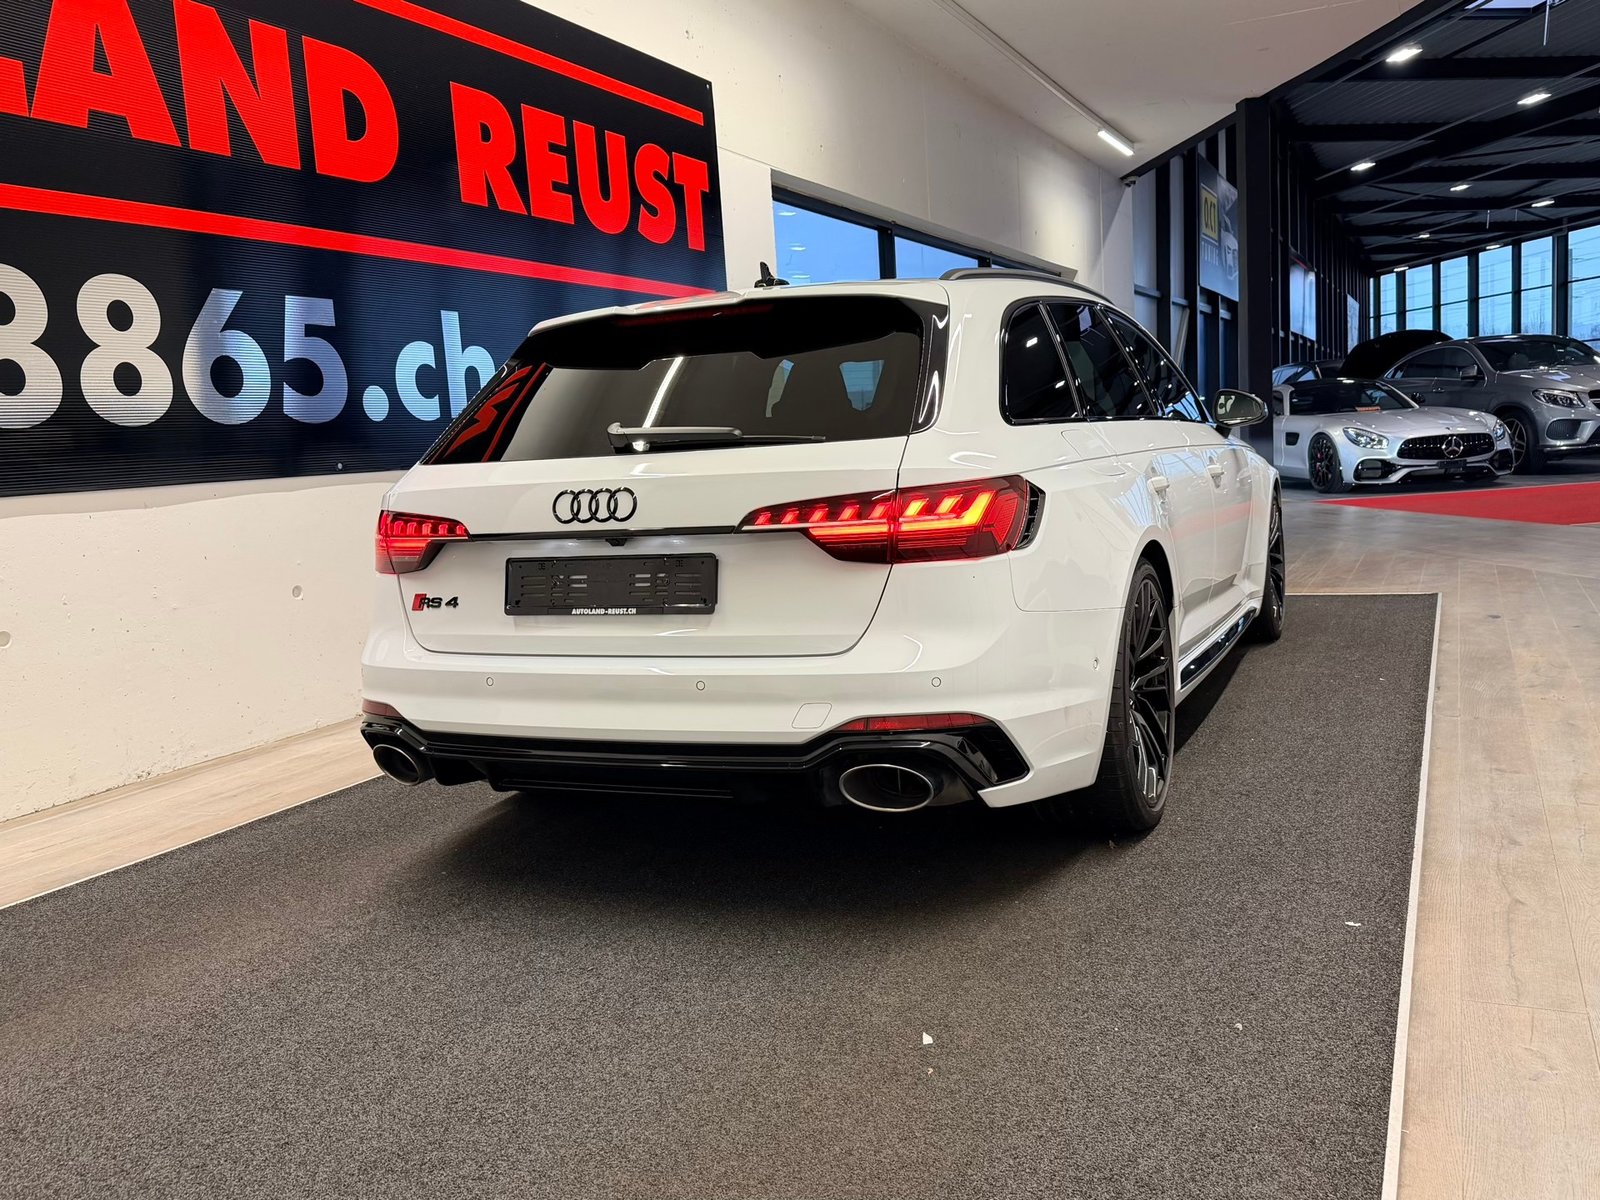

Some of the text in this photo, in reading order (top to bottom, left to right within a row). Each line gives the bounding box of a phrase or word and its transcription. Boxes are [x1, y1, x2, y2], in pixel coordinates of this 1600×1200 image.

[0, 0, 710, 252] AND REUST
[414, 595, 459, 610] RS 4
[571, 607, 637, 615] AUTOLAND-REUST.CH
